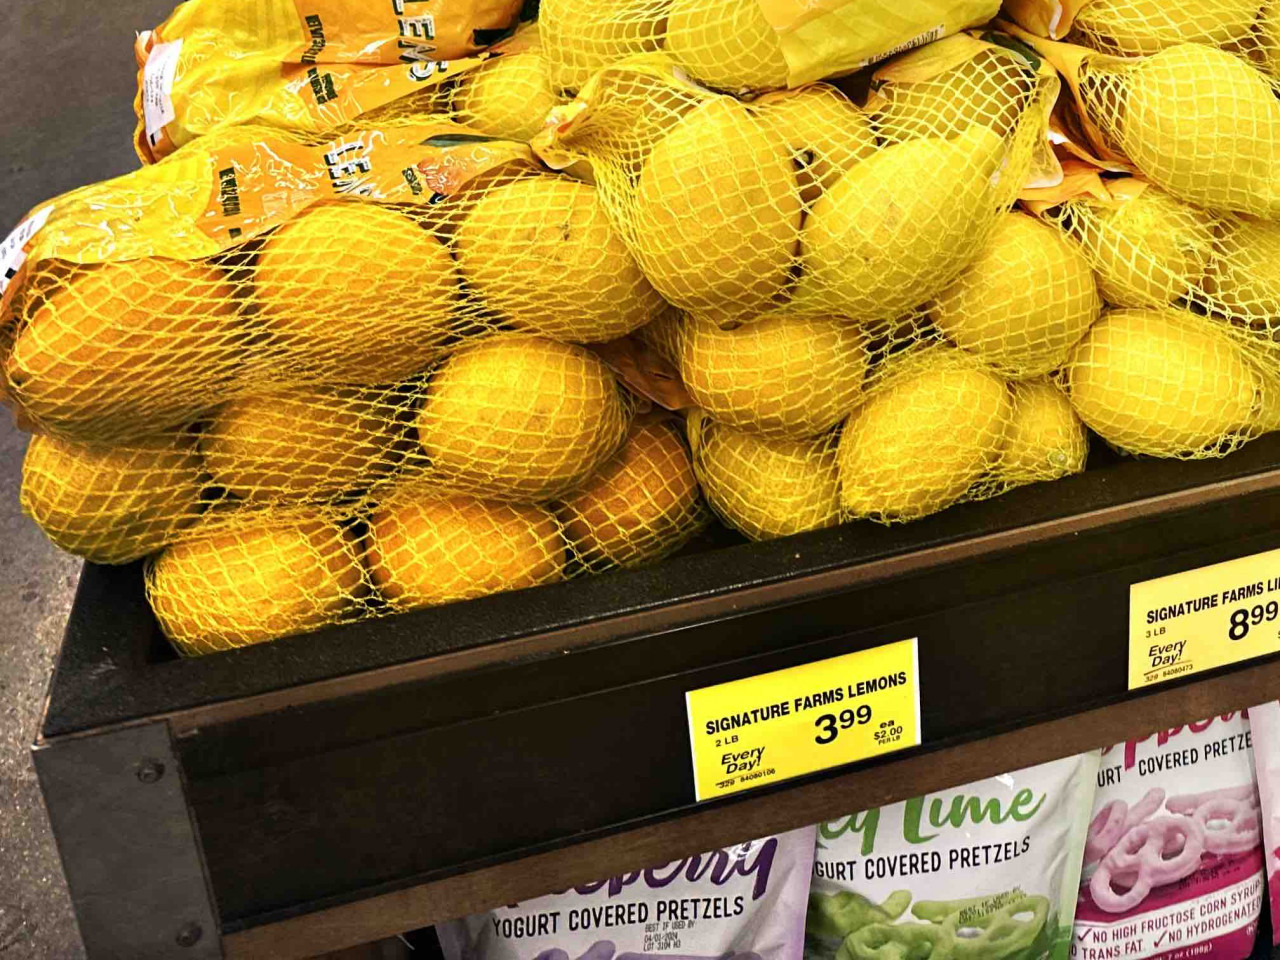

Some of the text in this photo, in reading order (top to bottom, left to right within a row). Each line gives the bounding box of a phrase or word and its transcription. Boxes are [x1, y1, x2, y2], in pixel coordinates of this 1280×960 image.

[1146, 594, 1219, 624] SIGNATURE
[1222, 581, 1264, 605] FARMS
[1145, 626, 1167, 639] 3 LB
[1148, 639, 1187, 658] Every
[1151, 649, 1183, 668] Day!
[706, 671, 907, 736] SIGNATURE FARMS LEMONS
[873, 725, 903, 742] $2.00
[879, 719, 895, 730] ea
[715, 734, 739, 748] 2 LB
[878, 734, 901, 746] PER LB
[721, 746, 766, 765] Every
[1097, 765, 1123, 788] URT
[1138, 748, 1199, 776] COVERED
[1204, 730, 1253, 760] PRETZE
[726, 757, 761, 775] Day!
[903, 788, 1047, 844] Lime
[812, 836, 1030, 881] GURT COVERED PRETZELS
[492, 896, 744, 939] YOGURT COVERED PRETZELS
[1093, 878, 1262, 943] NO HIGH FRUCTOSE CORN SYRUP
[1082, 896, 1262, 960] TRANS FAT NO HYDROGENATED
